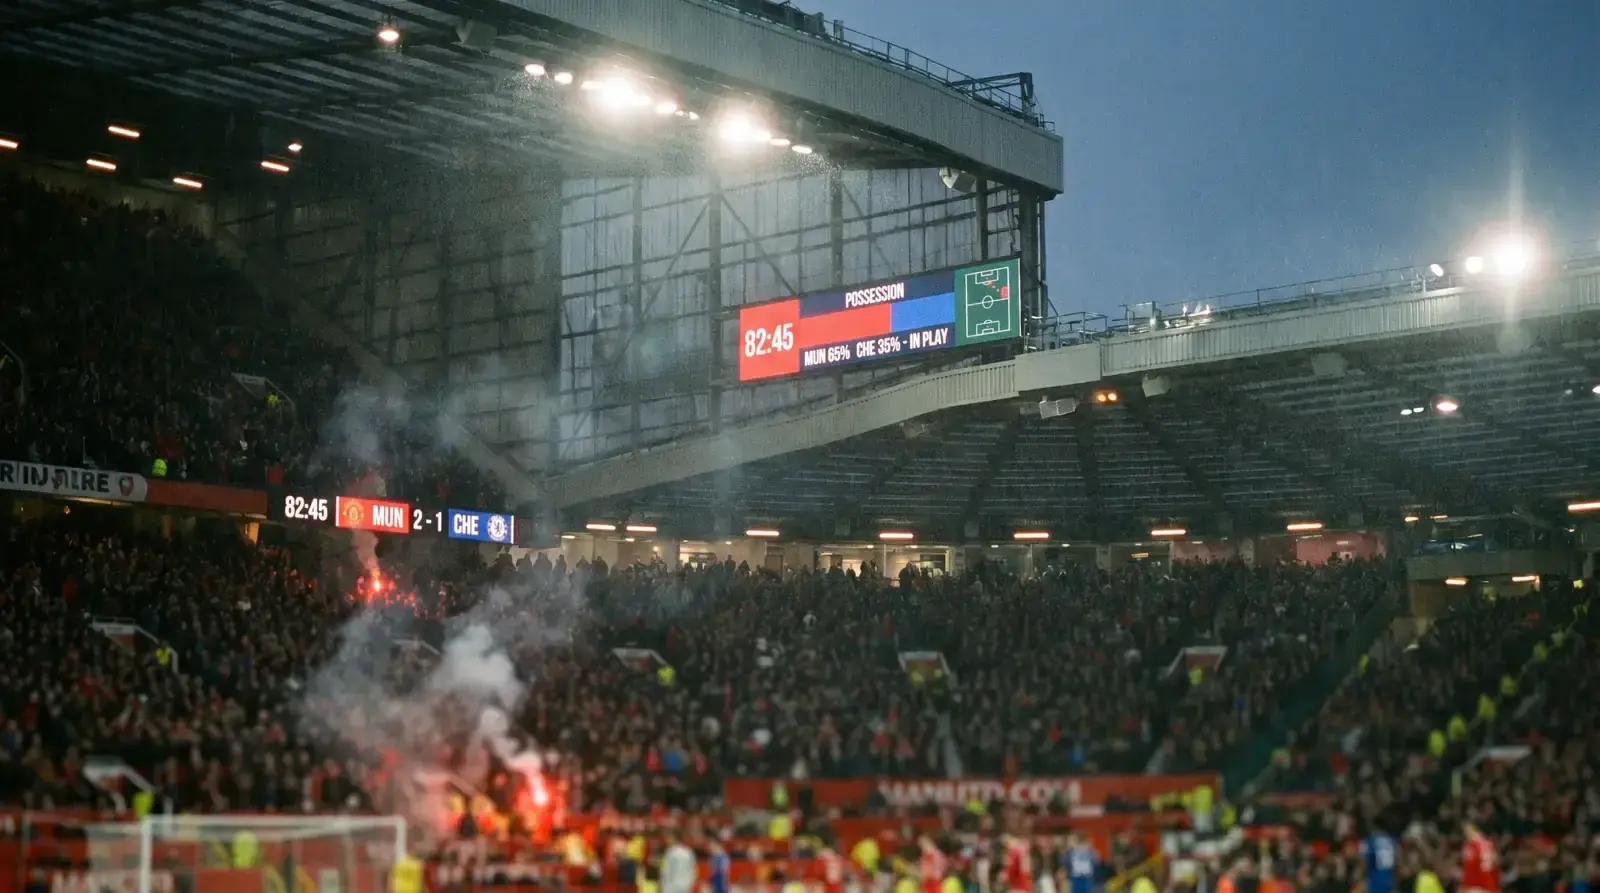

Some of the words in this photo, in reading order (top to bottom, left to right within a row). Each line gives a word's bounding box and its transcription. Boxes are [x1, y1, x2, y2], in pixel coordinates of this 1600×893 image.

[845, 282, 905, 309] POSSESSION
[744, 323, 794, 357] 82:45
[804, 347, 826, 367] MUN
[827, 344, 851, 363] 65%
[856, 339, 876, 358] CHE
[877, 335, 901, 355] 35%
[909, 332, 921, 350] IN
[922, 327, 949, 348] PLAY
[285, 495, 328, 521] 82:45
[372, 505, 404, 528] MUN
[413, 508, 423, 530] 2
[435, 511, 442, 532] 1
[453, 513, 479, 536] CHE
